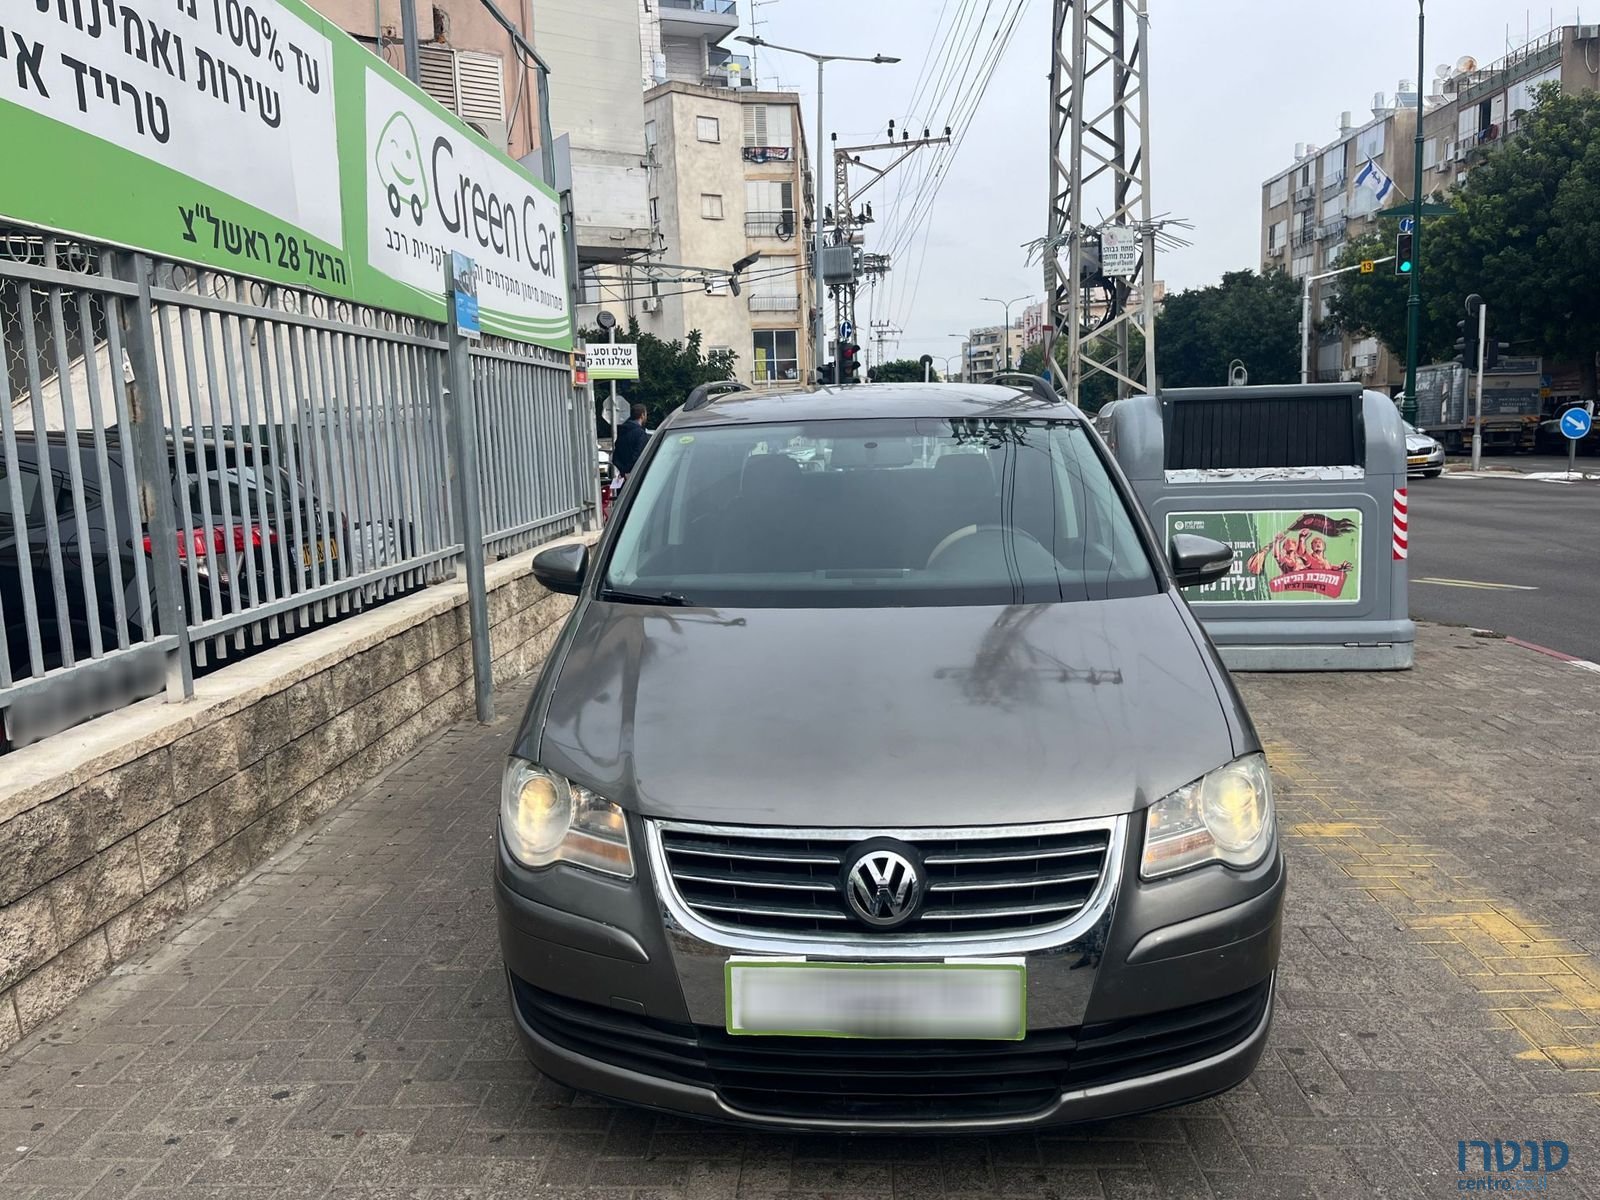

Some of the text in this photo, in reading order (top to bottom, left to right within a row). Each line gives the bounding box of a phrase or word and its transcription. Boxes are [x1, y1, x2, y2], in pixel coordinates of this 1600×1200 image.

[213, 0, 320, 95] עד 100%
[61, 53, 170, 144] טרייד
[195, 46, 281, 129] שירות
[432, 136, 556, 280] Green Car
[274, 232, 300, 272] 28
[385, 227, 409, 255] רכב
[303, 239, 346, 286] הרצל
[1363, 262, 1372, 271] 13
[486, 268, 521, 296] מתקדמים
[595, 358, 606, 366] זה
[608, 356, 633, 366] אצלנו
[612, 346, 632, 356] שלם
[1220, 575, 1256, 592] עליה
[1306, 572, 1340, 586] מהפכת
